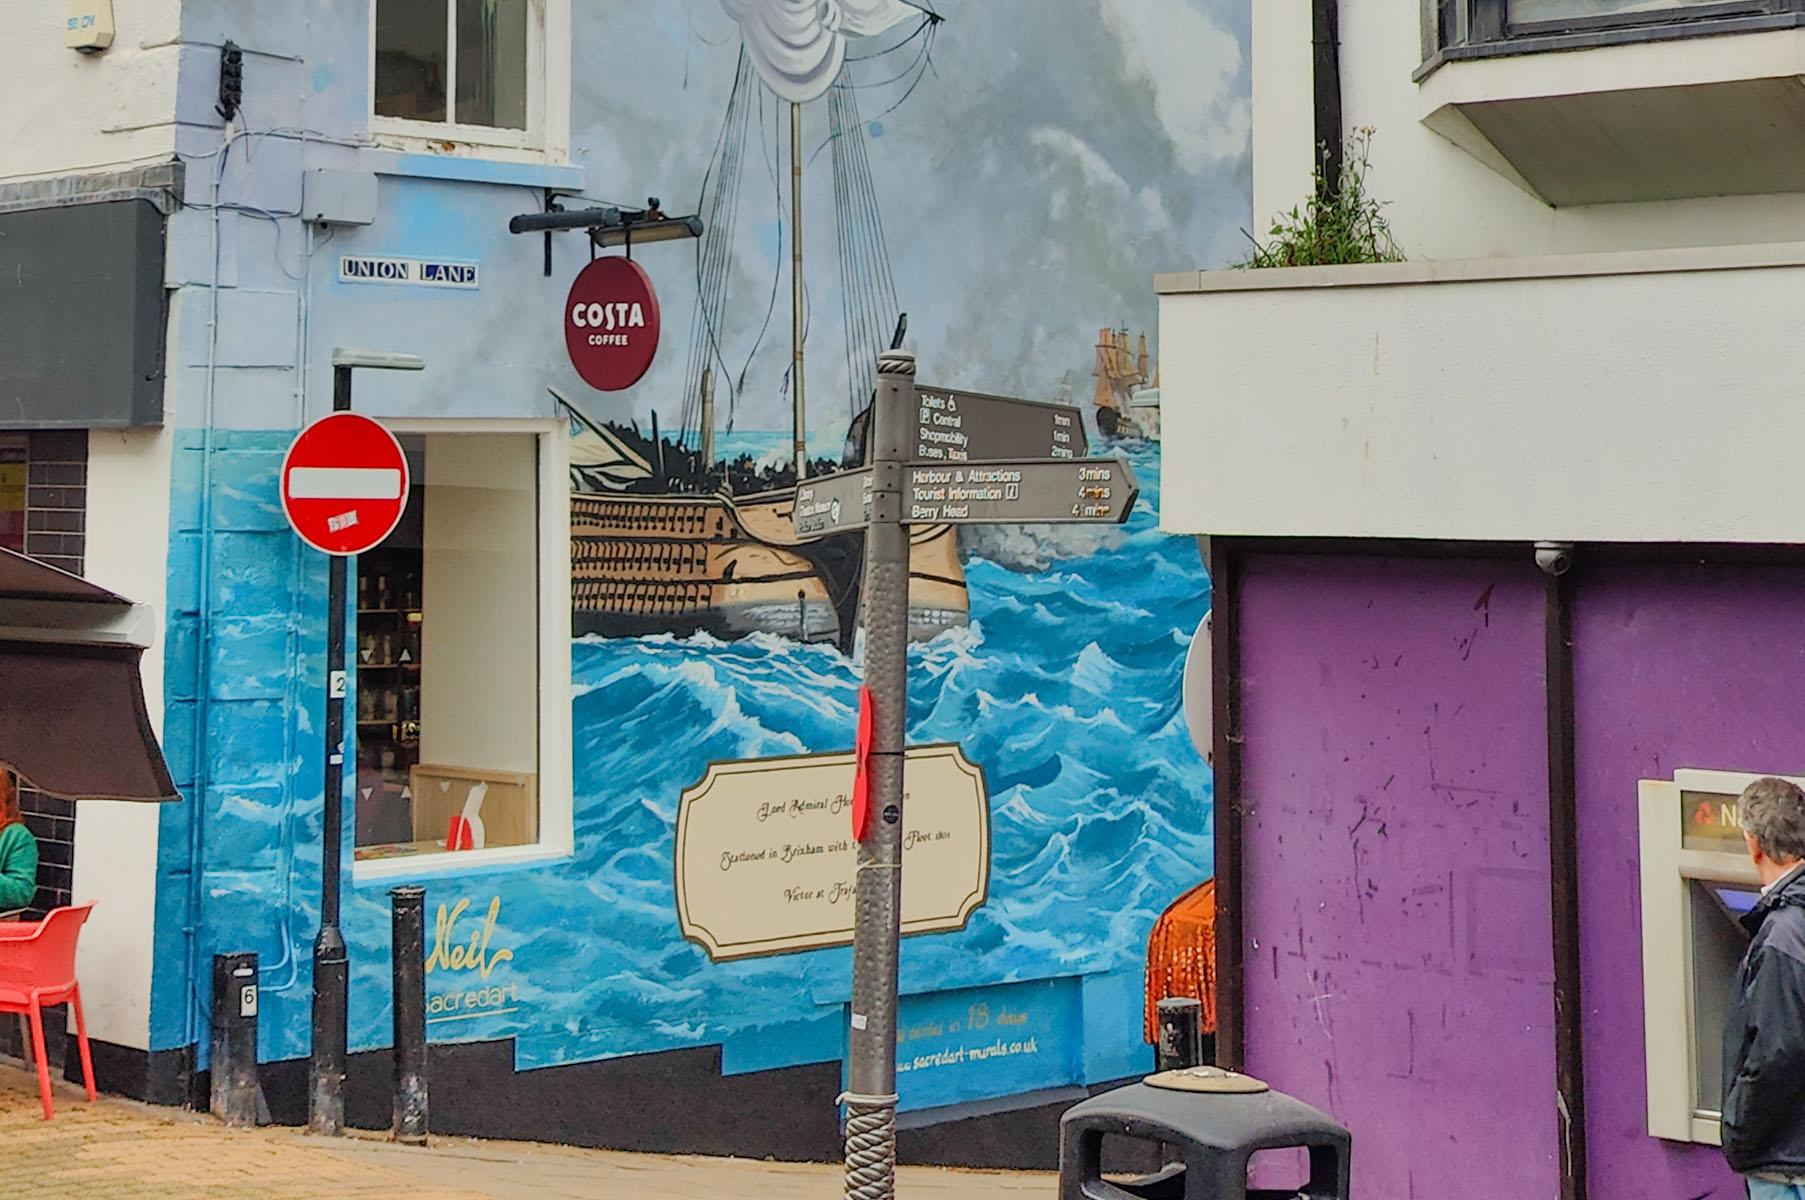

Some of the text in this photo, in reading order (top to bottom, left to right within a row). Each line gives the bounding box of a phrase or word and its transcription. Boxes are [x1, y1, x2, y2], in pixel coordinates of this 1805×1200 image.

[343, 258, 476, 284] UNION LANE
[572, 302, 645, 331] COSTA
[588, 334, 628, 346] COFFEE
[920, 394, 946, 410] Toilets
[932, 412, 962, 428] Central
[920, 427, 968, 449] Shopmobility
[912, 470, 952, 484] Harbour
[955, 470, 965, 483] &
[968, 468, 1022, 483] Attractions
[912, 486, 946, 500] Tourist
[948, 486, 1002, 500] Information
[911, 504, 939, 520] Berry
[942, 504, 969, 518] Head
[336, 677, 345, 691] 2
[756, 802, 786, 822] Lord
[789, 798, 828, 818] Admiral
[769, 848, 778, 859] in
[781, 843, 824, 863] Brixham
[828, 840, 848, 852] with
[426, 895, 514, 978] Neil
[243, 988, 254, 1004] 6
